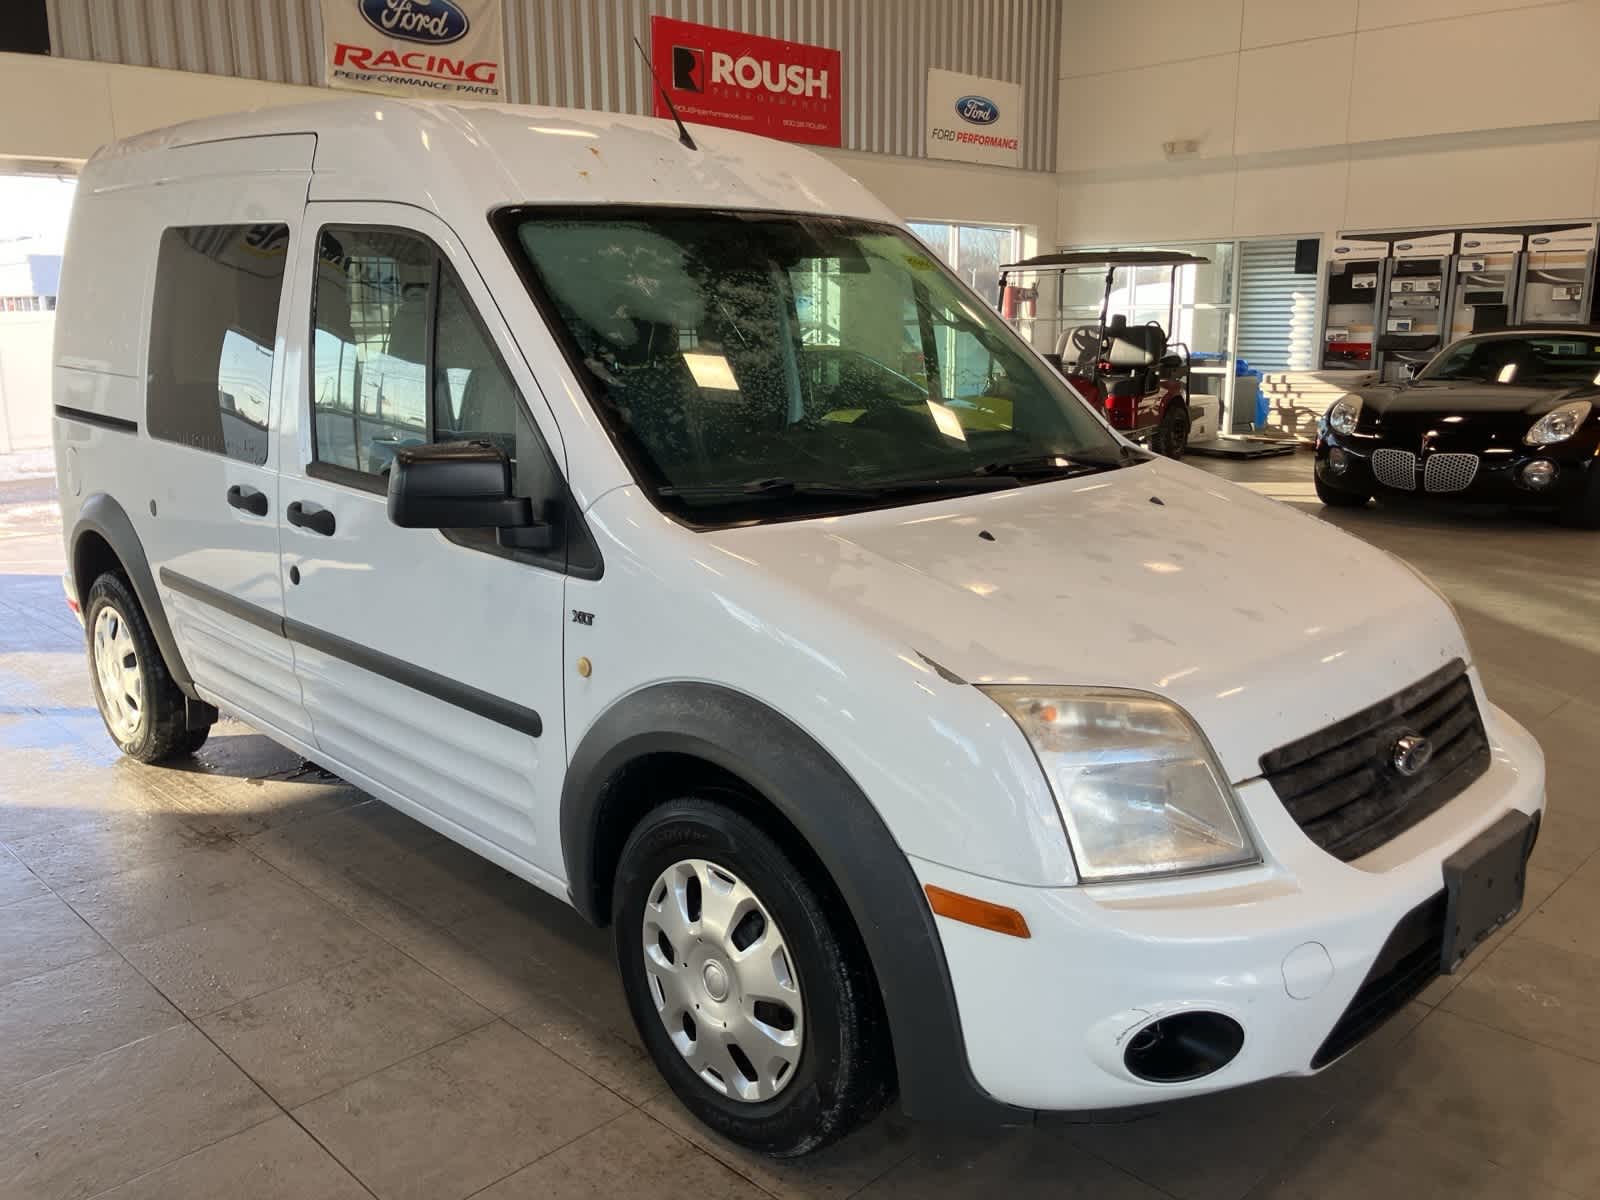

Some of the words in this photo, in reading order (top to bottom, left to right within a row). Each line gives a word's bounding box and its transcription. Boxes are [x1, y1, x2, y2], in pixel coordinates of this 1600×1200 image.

[381, 0, 449, 36] Ford
[334, 42, 497, 84] RACING
[711, 51, 829, 99] ROUSH
[333, 70, 450, 90] PERFORMANCE
[456, 85, 498, 95] PARTS
[964, 99, 991, 120] Ford
[932, 128, 955, 141] FORD
[957, 132, 1018, 150] PERFORMANCE
